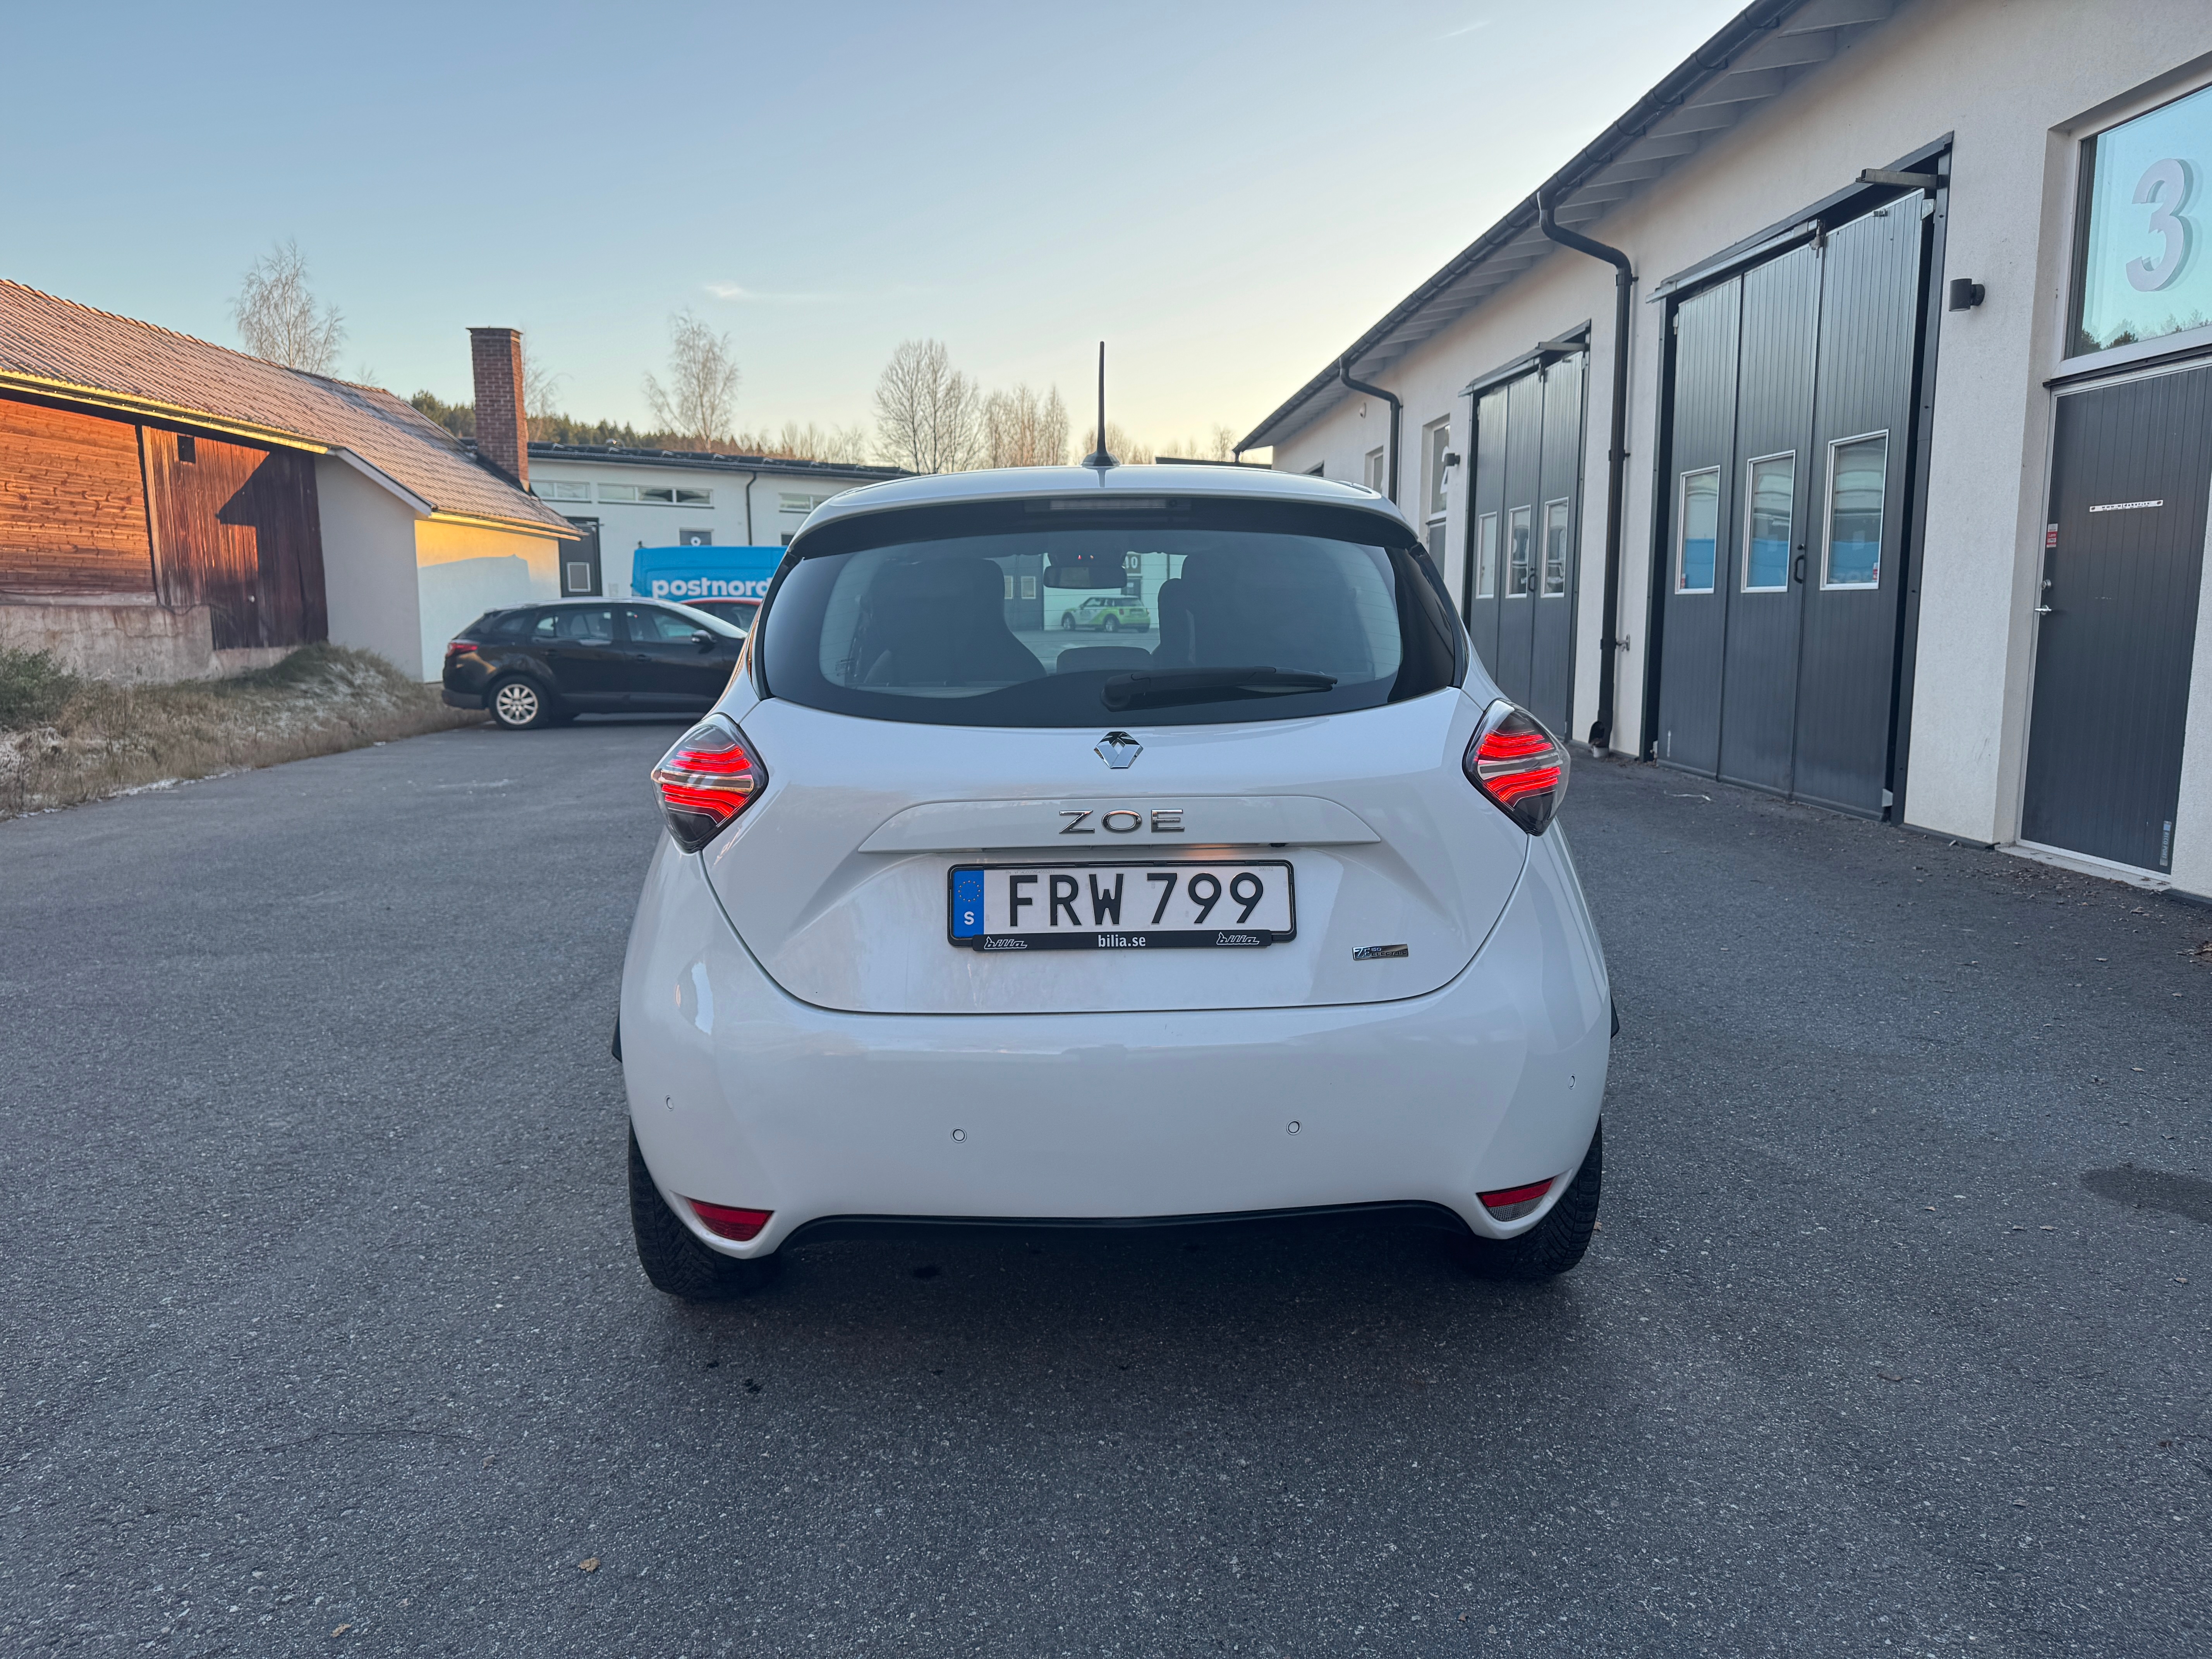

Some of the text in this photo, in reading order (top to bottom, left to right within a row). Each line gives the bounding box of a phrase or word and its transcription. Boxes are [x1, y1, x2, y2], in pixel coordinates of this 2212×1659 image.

[2126, 158, 2193, 292] 3
[652, 577, 772, 599] postnord
[1059, 809, 1185, 834] ZOE
[1010, 872, 1264, 927] FRW 799
[963, 911, 974, 925] S
[984, 936, 1027, 949] bilia
[1097, 934, 1146, 947] bilia.se
[1216, 932, 1260, 945] bilia
